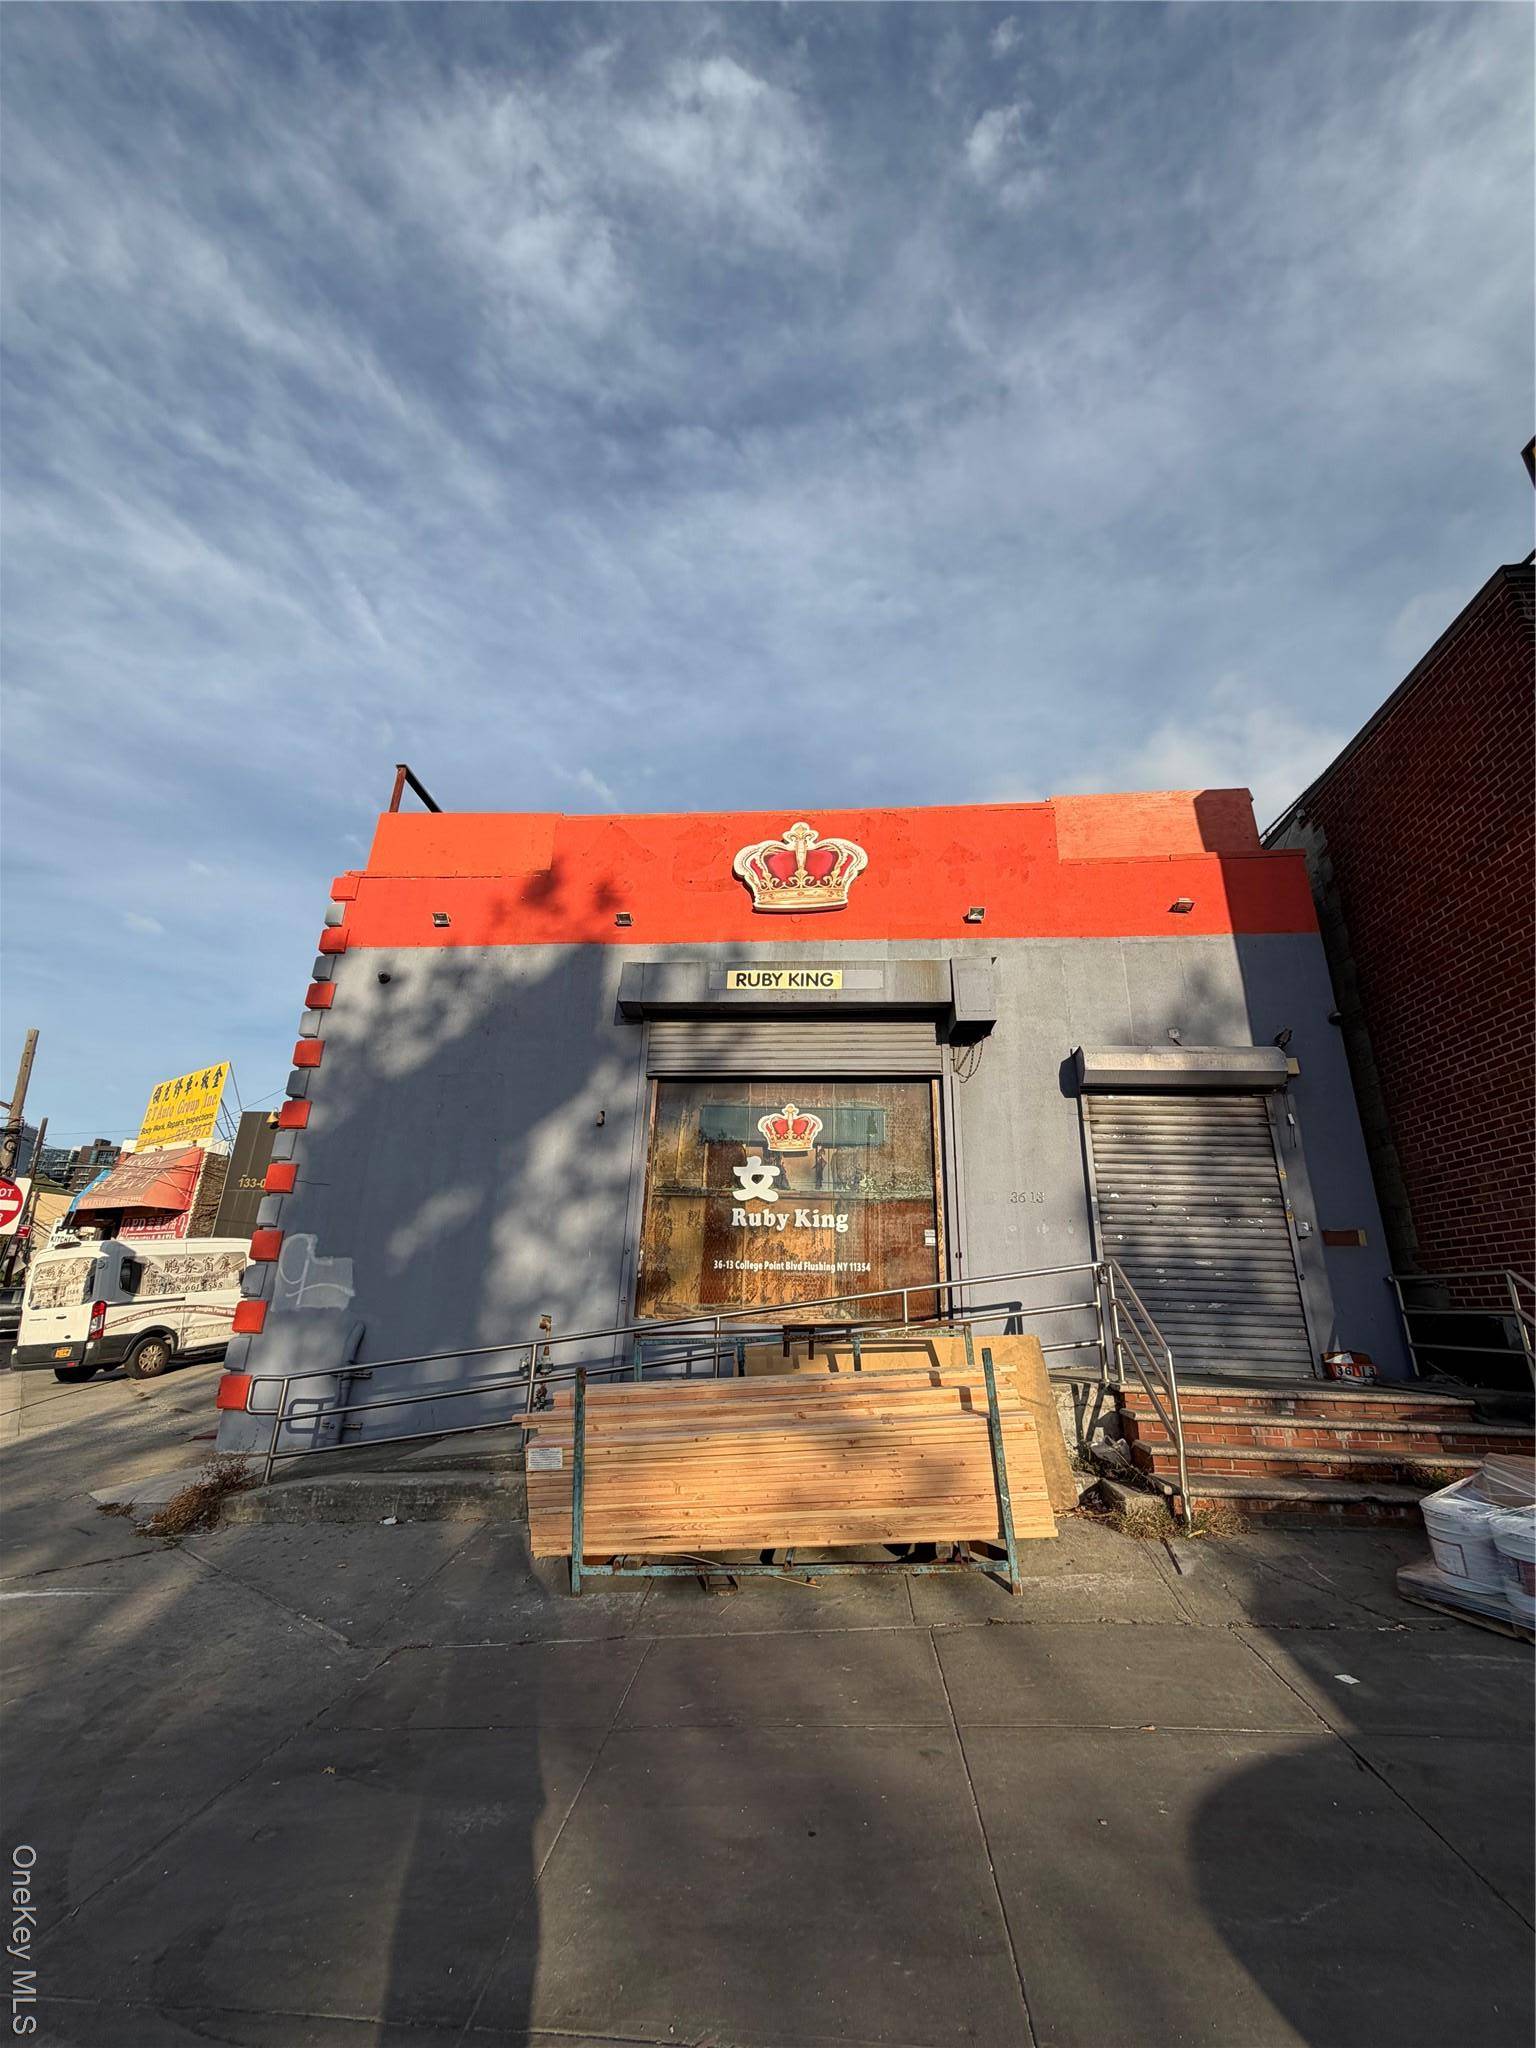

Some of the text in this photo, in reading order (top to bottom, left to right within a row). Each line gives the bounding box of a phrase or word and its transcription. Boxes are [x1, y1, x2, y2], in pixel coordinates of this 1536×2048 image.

[736, 972, 834, 987] RUBY KING
[176, 1099, 200, 1115] Group
[0, 1188, 14, 1197] OT
[1010, 1191, 1044, 1203] 36 13
[732, 1207, 849, 1233] Ruby King
[713, 1260, 871, 1273] 36-13 College Point Blvd Flushing NY 11354
[1335, 1366, 1352, 1376] 36
